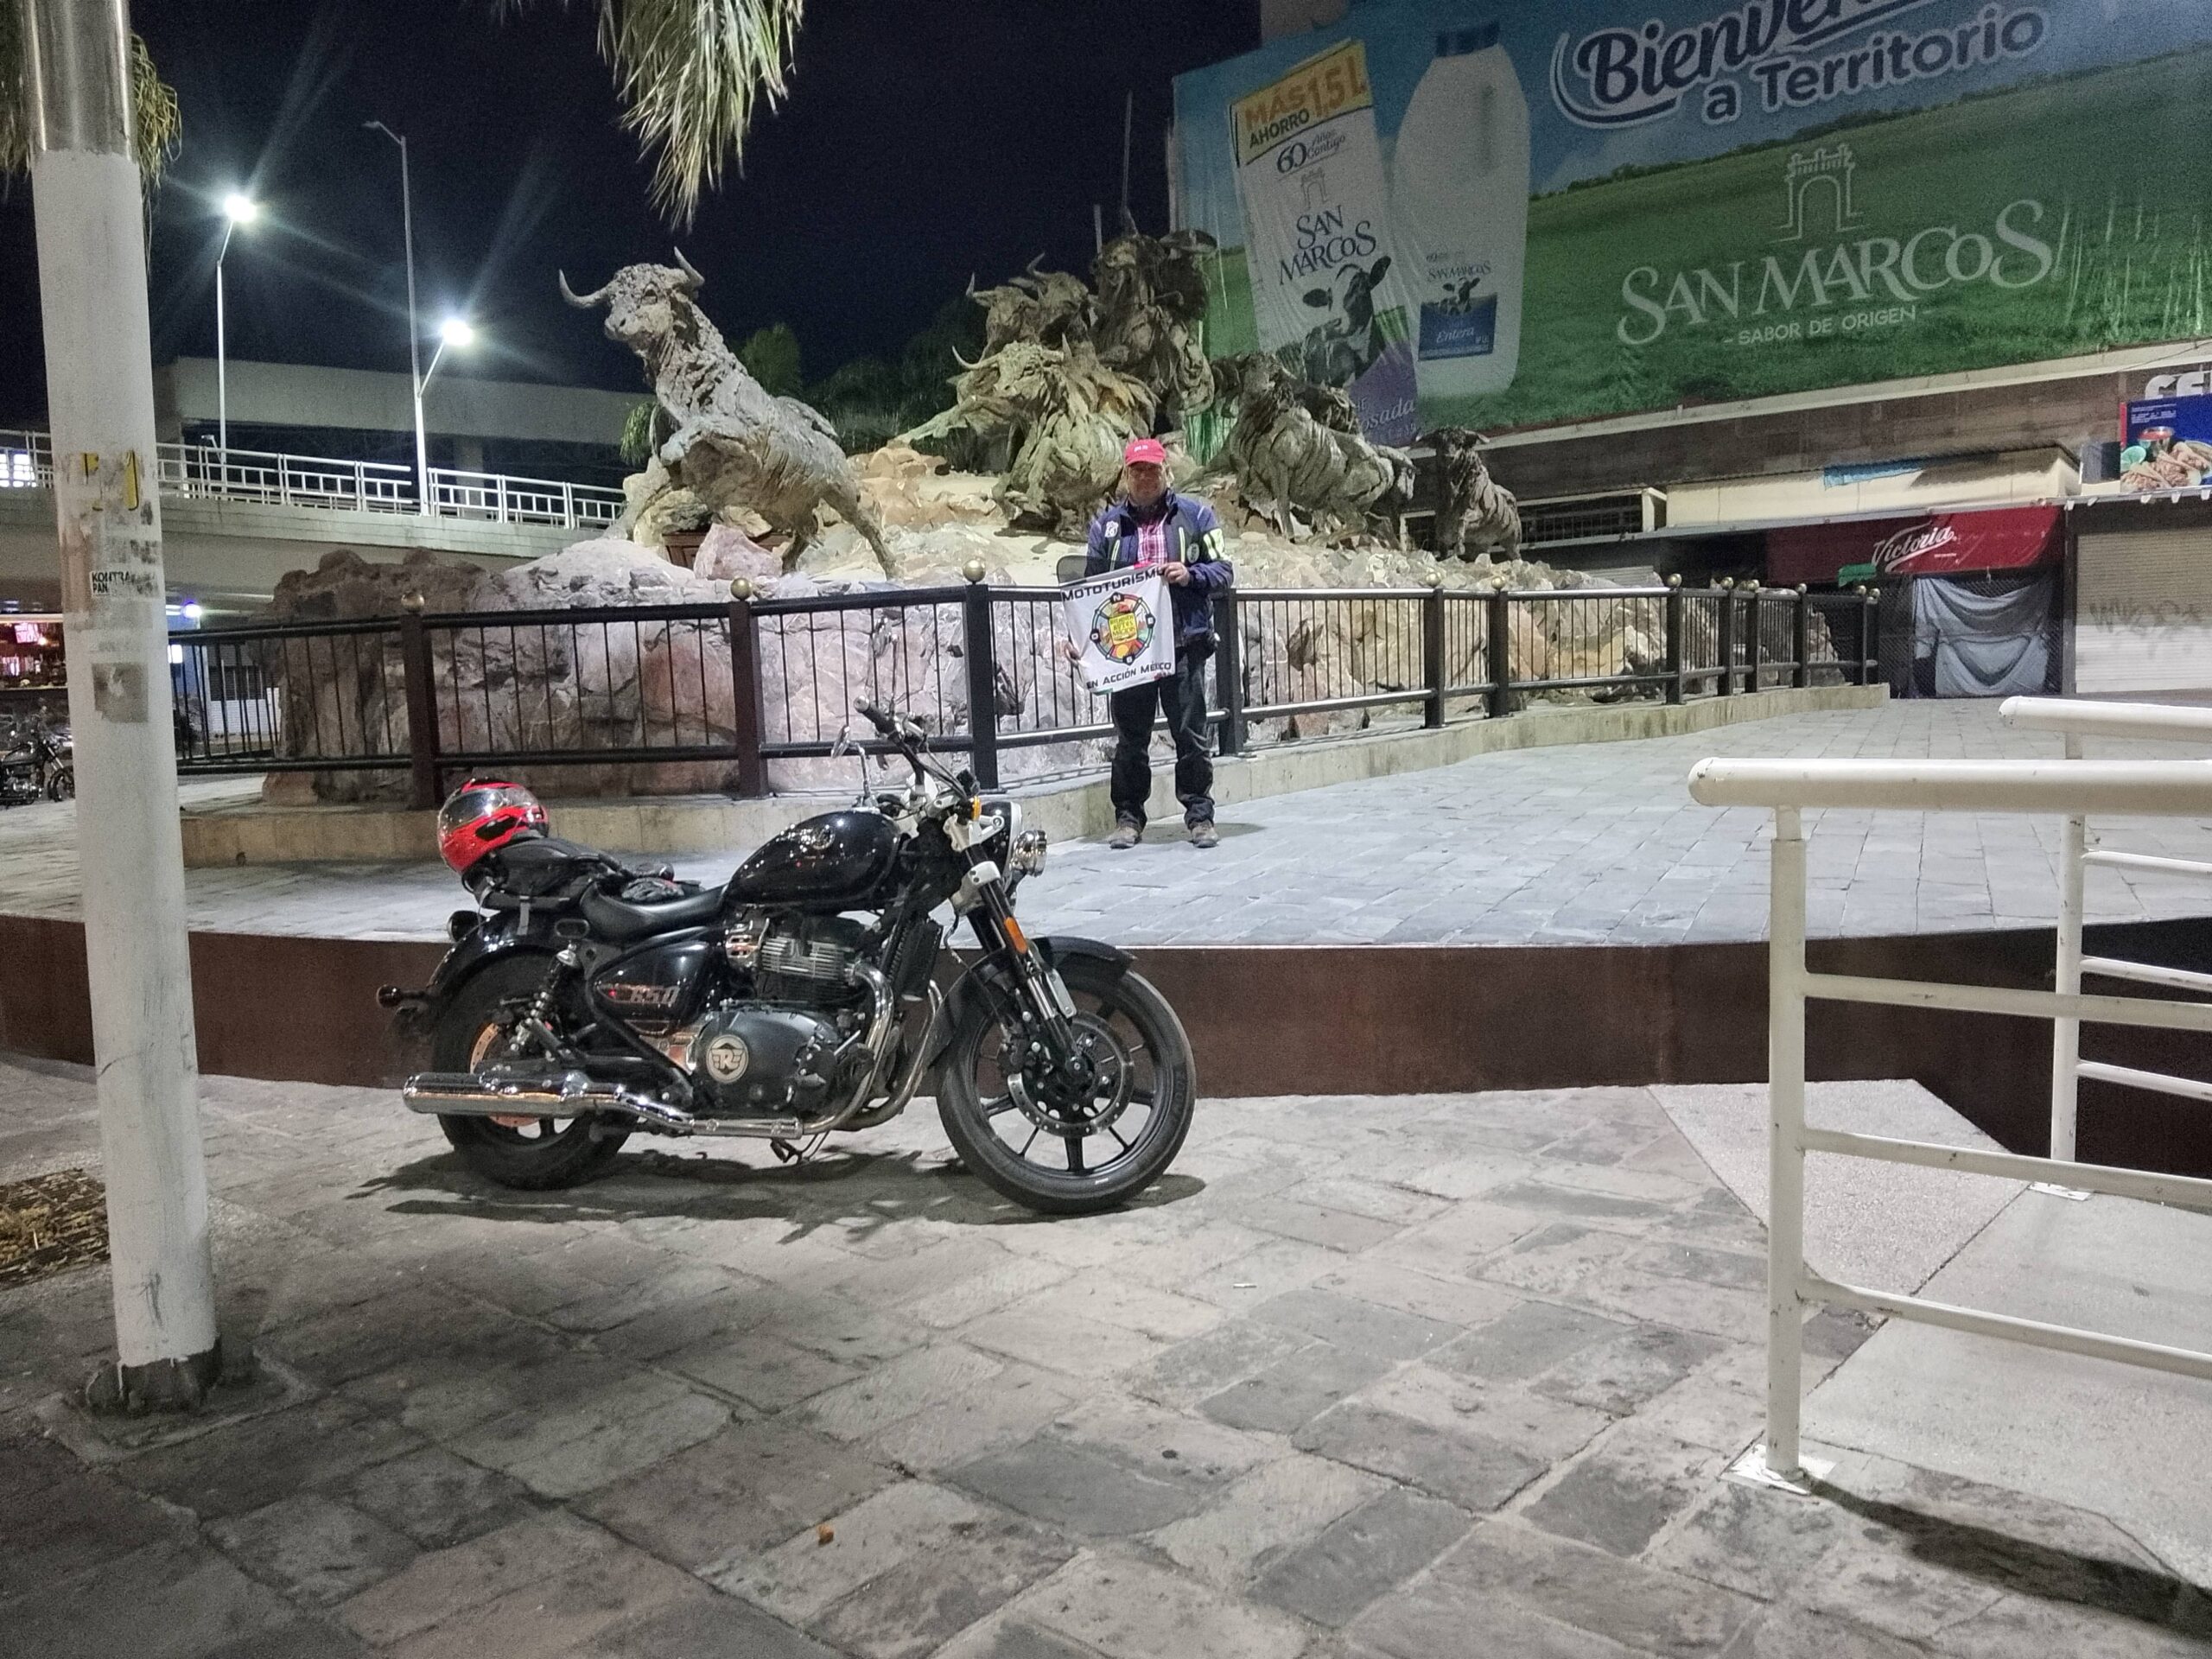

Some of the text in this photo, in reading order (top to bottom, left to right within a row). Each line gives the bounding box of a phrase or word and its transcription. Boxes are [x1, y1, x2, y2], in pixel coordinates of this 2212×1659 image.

[1575, 0, 1840, 105] Bienve
[1704, 6, 2046, 122] a Territorio
[1249, 108, 1310, 149] AHORRO
[1276, 142, 1307, 173] 60
[1296, 205, 1344, 250] SAN
[1280, 220, 1376, 285] MARCOS
[1617, 199, 2053, 345] SAN MARCOS
[1738, 305, 1916, 346] SABOR DE ORIGEN
[1872, 520, 1957, 568] Victoria
[1086, 678, 1099, 690] EN
[1103, 666, 1137, 685] ACCIÓN
[630, 986, 680, 1005] 650
